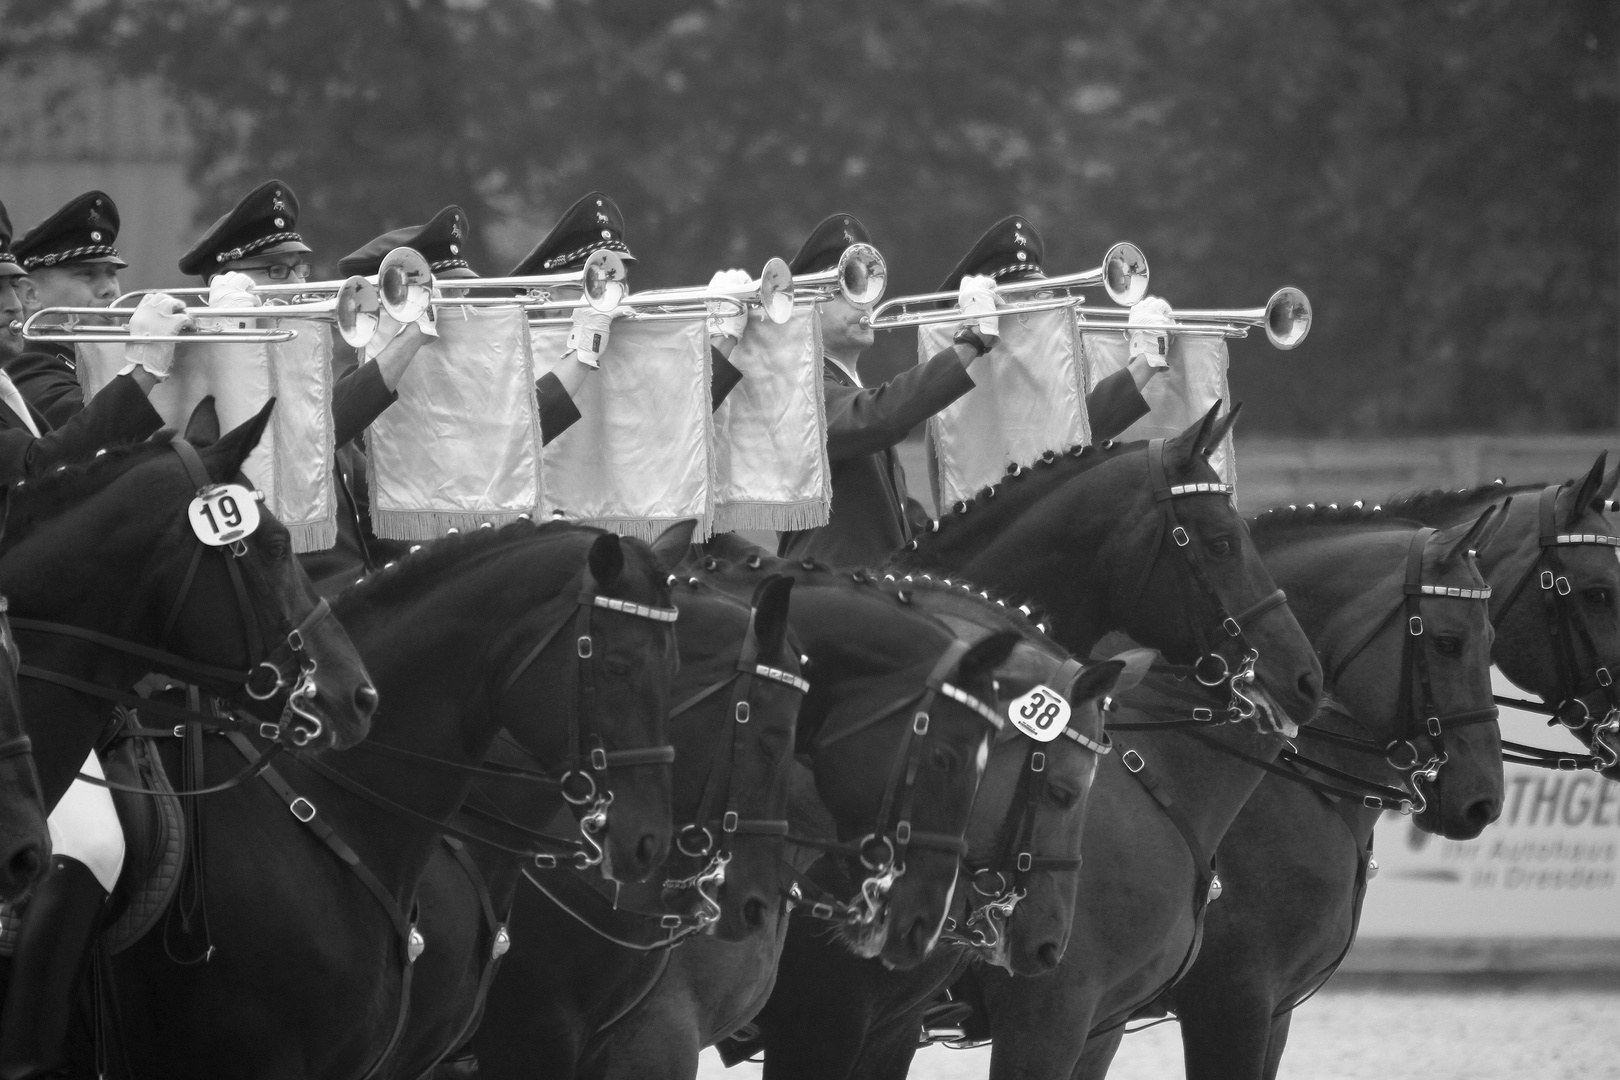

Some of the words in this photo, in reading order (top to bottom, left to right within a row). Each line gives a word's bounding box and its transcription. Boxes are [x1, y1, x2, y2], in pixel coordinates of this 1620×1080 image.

[199, 495, 242, 535] 19
[1020, 692, 1060, 730] 38
[1500, 775, 1620, 827] THGE
